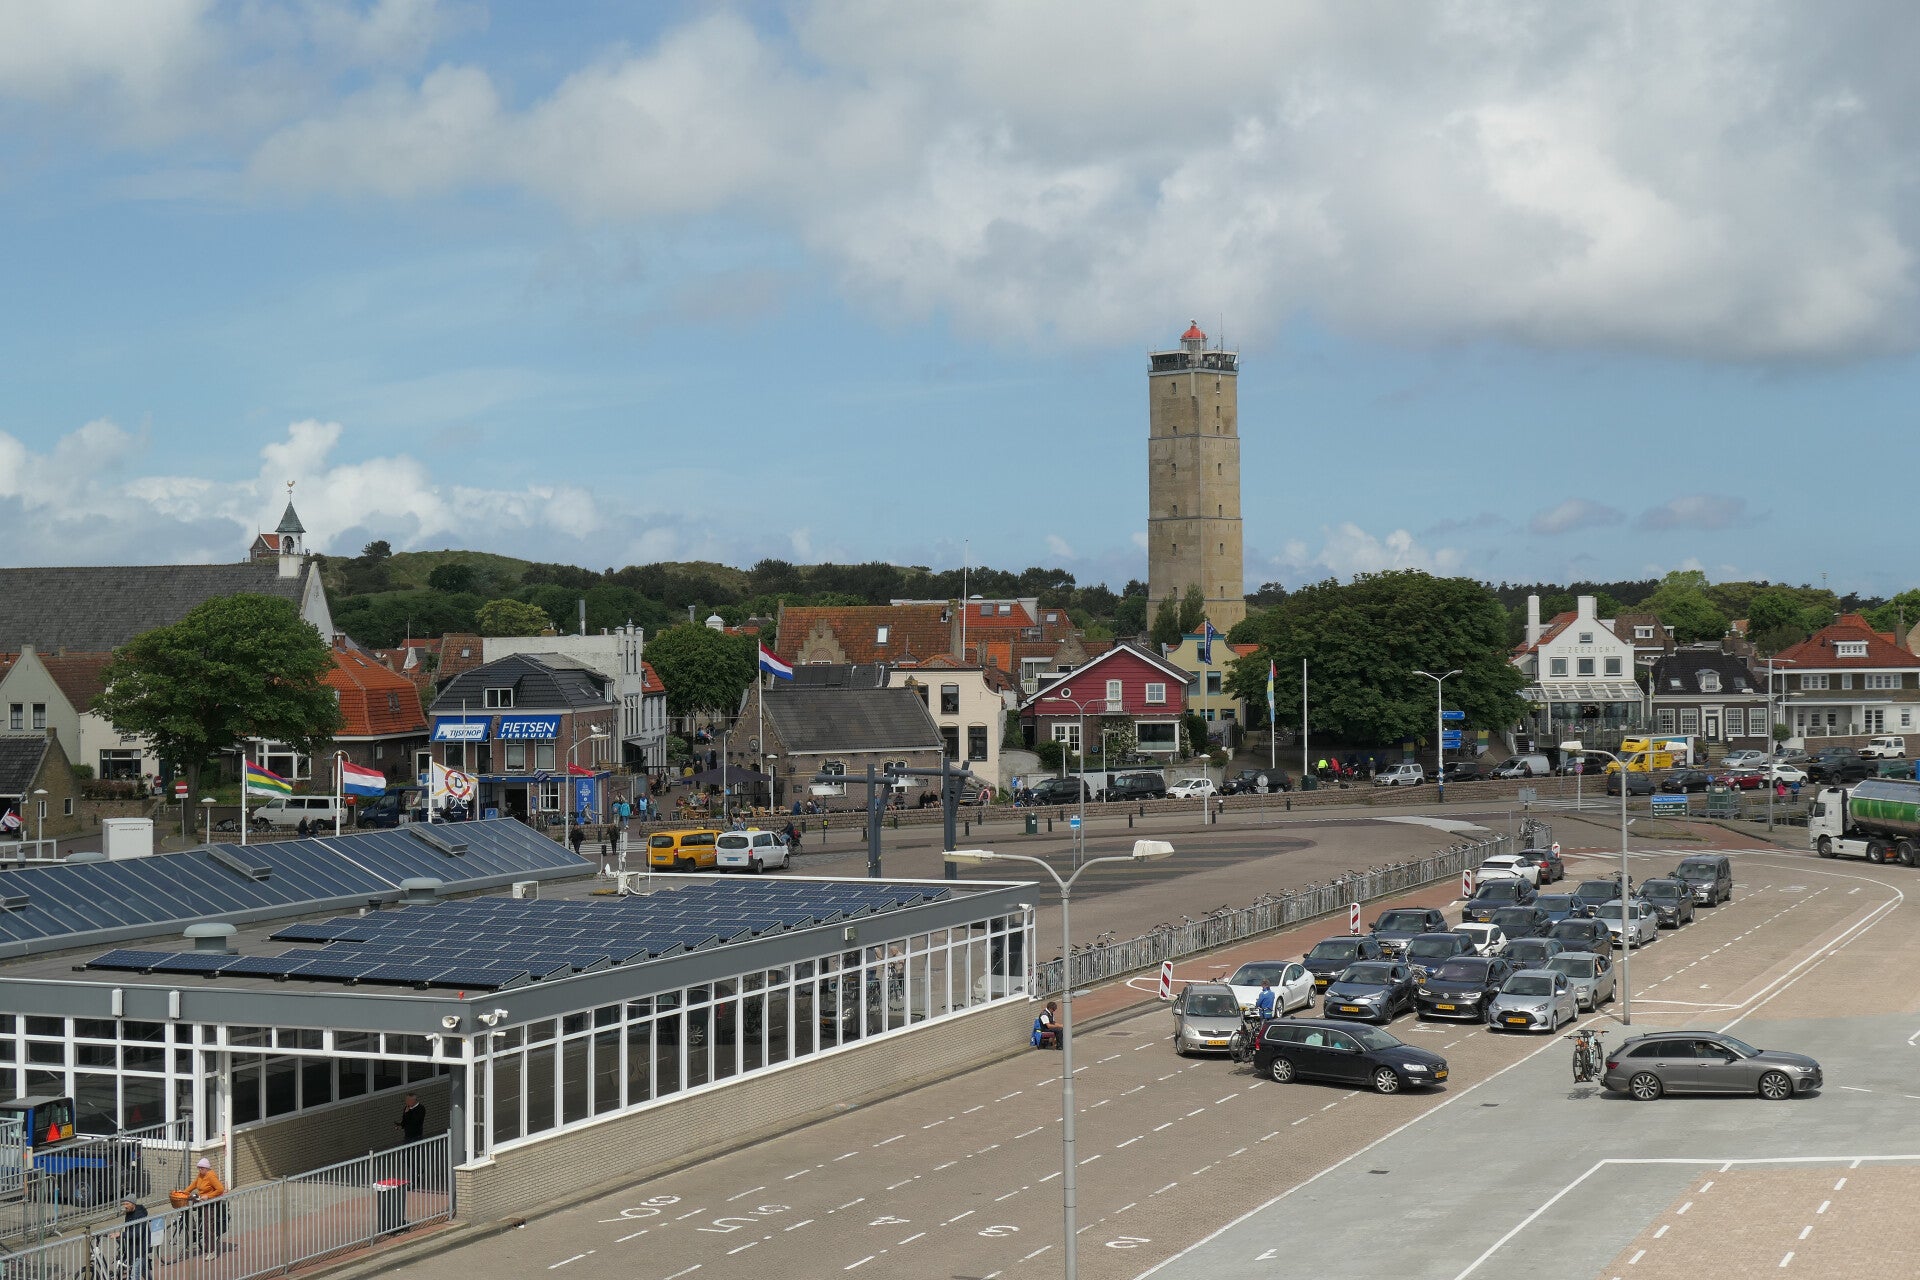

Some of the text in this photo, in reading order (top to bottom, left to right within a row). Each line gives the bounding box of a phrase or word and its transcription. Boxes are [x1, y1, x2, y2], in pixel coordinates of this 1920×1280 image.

[1568, 646, 1616, 654] ZEEZICHT
[501, 722, 556, 733] FIETSEN
[454, 777, 464, 788] D
[598, 1207, 662, 1223] 6
[696, 1217, 759, 1233] 5
[1105, 1236, 1151, 1249] 2
